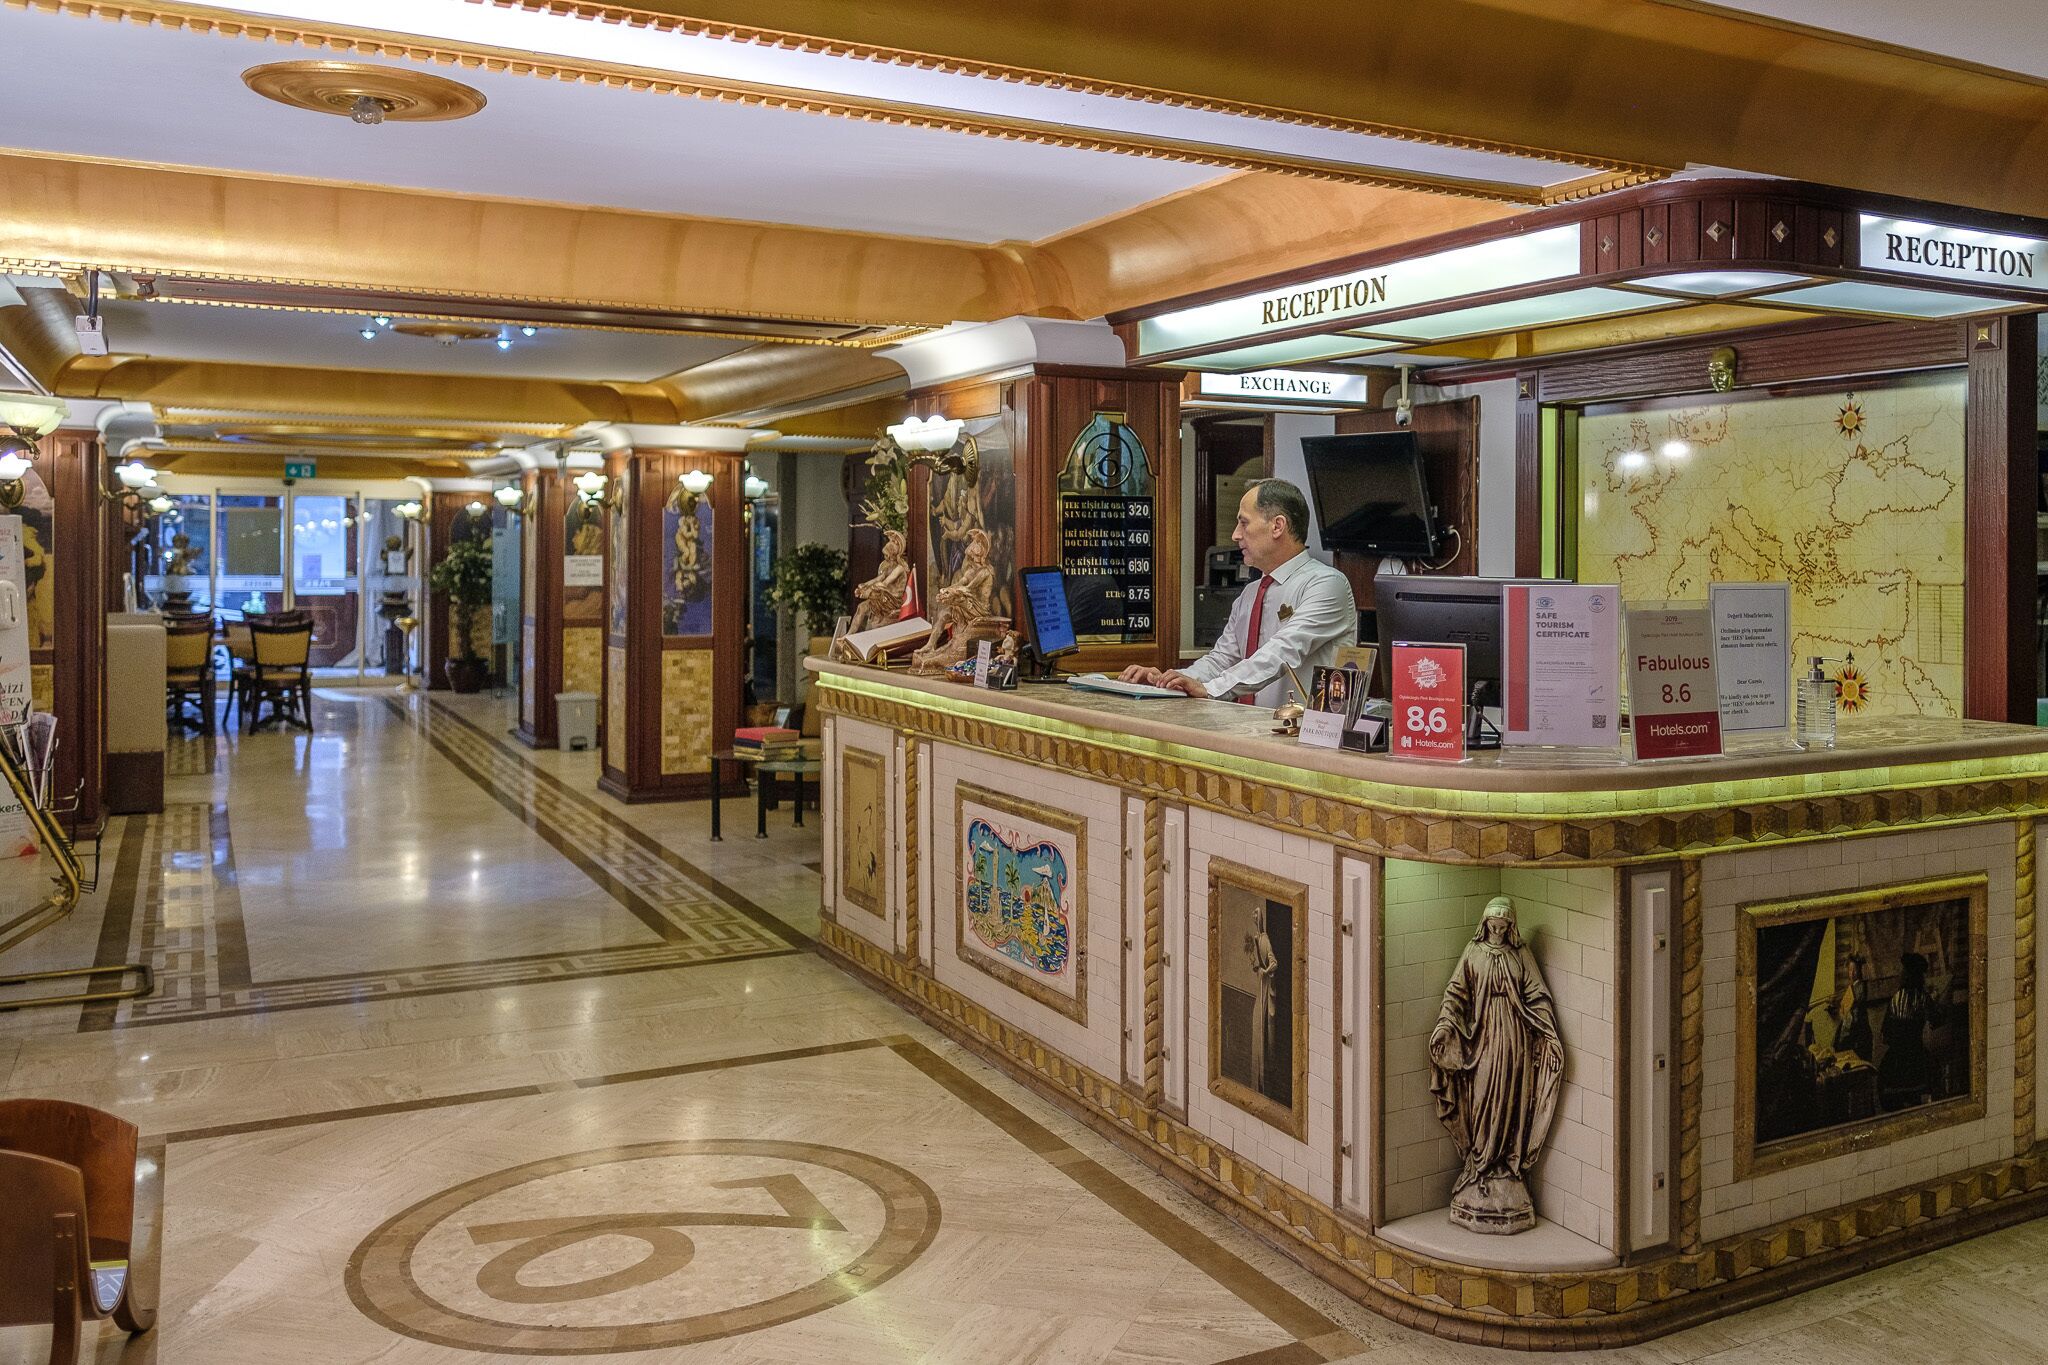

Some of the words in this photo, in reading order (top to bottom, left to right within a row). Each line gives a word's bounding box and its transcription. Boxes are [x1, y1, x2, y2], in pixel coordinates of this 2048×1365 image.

[1886, 233, 2035, 278] RECEPTION
[1262, 275, 1387, 325] RECEPTION
[1240, 376, 1331, 394] EXCHANGE
[1128, 504, 1149, 516] 320
[1128, 532, 1149, 544] 460
[1077, 556, 1108, 567] KİŞİLİK
[1128, 561, 1149, 572] 630
[1128, 589, 1150, 600] 8.75
[1128, 617, 1150, 628] 7.50
[1638, 654, 1710, 671] Fabulous
[1662, 683, 1691, 703] 8.6
[1406, 706, 1447, 736] 8,6
[1650, 724, 1708, 736] Hotels.com
[1415, 739, 1454, 749] Hotels.com
